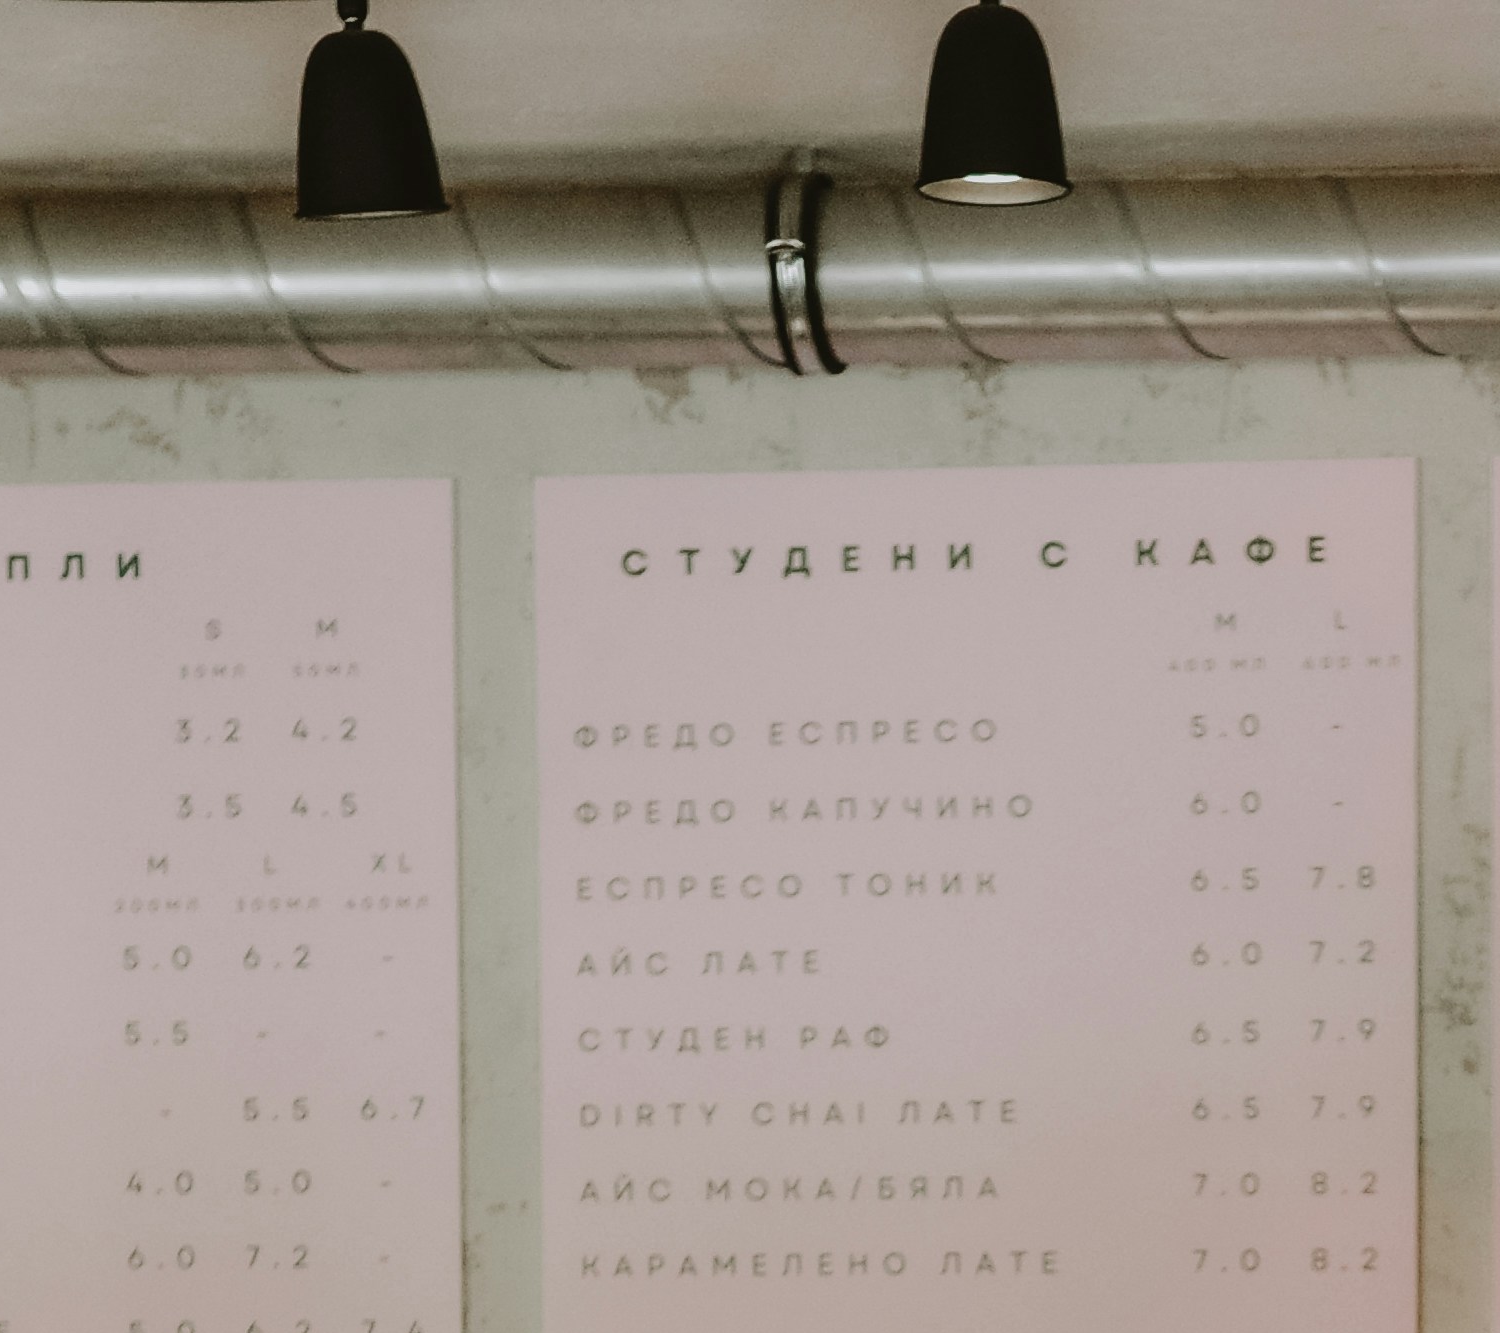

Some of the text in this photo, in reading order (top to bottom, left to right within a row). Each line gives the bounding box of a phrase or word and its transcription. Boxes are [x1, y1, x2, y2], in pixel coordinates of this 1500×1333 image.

[621, 535, 1325, 578] СТУДЕНИ С КАФЕ
[176, 718, 241, 744] 3.2
[573, 712, 1261, 751] ФРЕДО ЕСПРЕСО 5.0
[177, 793, 243, 820] 3.5
[291, 792, 358, 818] 4.5
[574, 793, 1033, 827] ФРЕДО КАПУЧИНО
[576, 864, 1376, 902] ЕСПРЕСО ТОНИК 6.5 7.8
[242, 944, 310, 970] 6.2
[577, 939, 1376, 977] АЙС ЛАТЕ 7.2
[124, 1020, 190, 1047] 5.5
[577, 1019, 1260, 1055] СТУДЕН РАФ 6.5
[359, 1095, 426, 1121] 6.7
[579, 1094, 1377, 1129] DIRTY CHAI ЛАТЕ 6.5 7.9
[126, 1170, 195, 1196] 4.0
[579, 1170, 1378, 1203] АЙС МОКА/БЯЛА 8.2
[127, 1244, 197, 1271] 6.0
[247, 1244, 309, 1270] 7.2
[581, 1247, 1262, 1277] КАРАМЕЛЕНО ЛАТЕ 7.0
